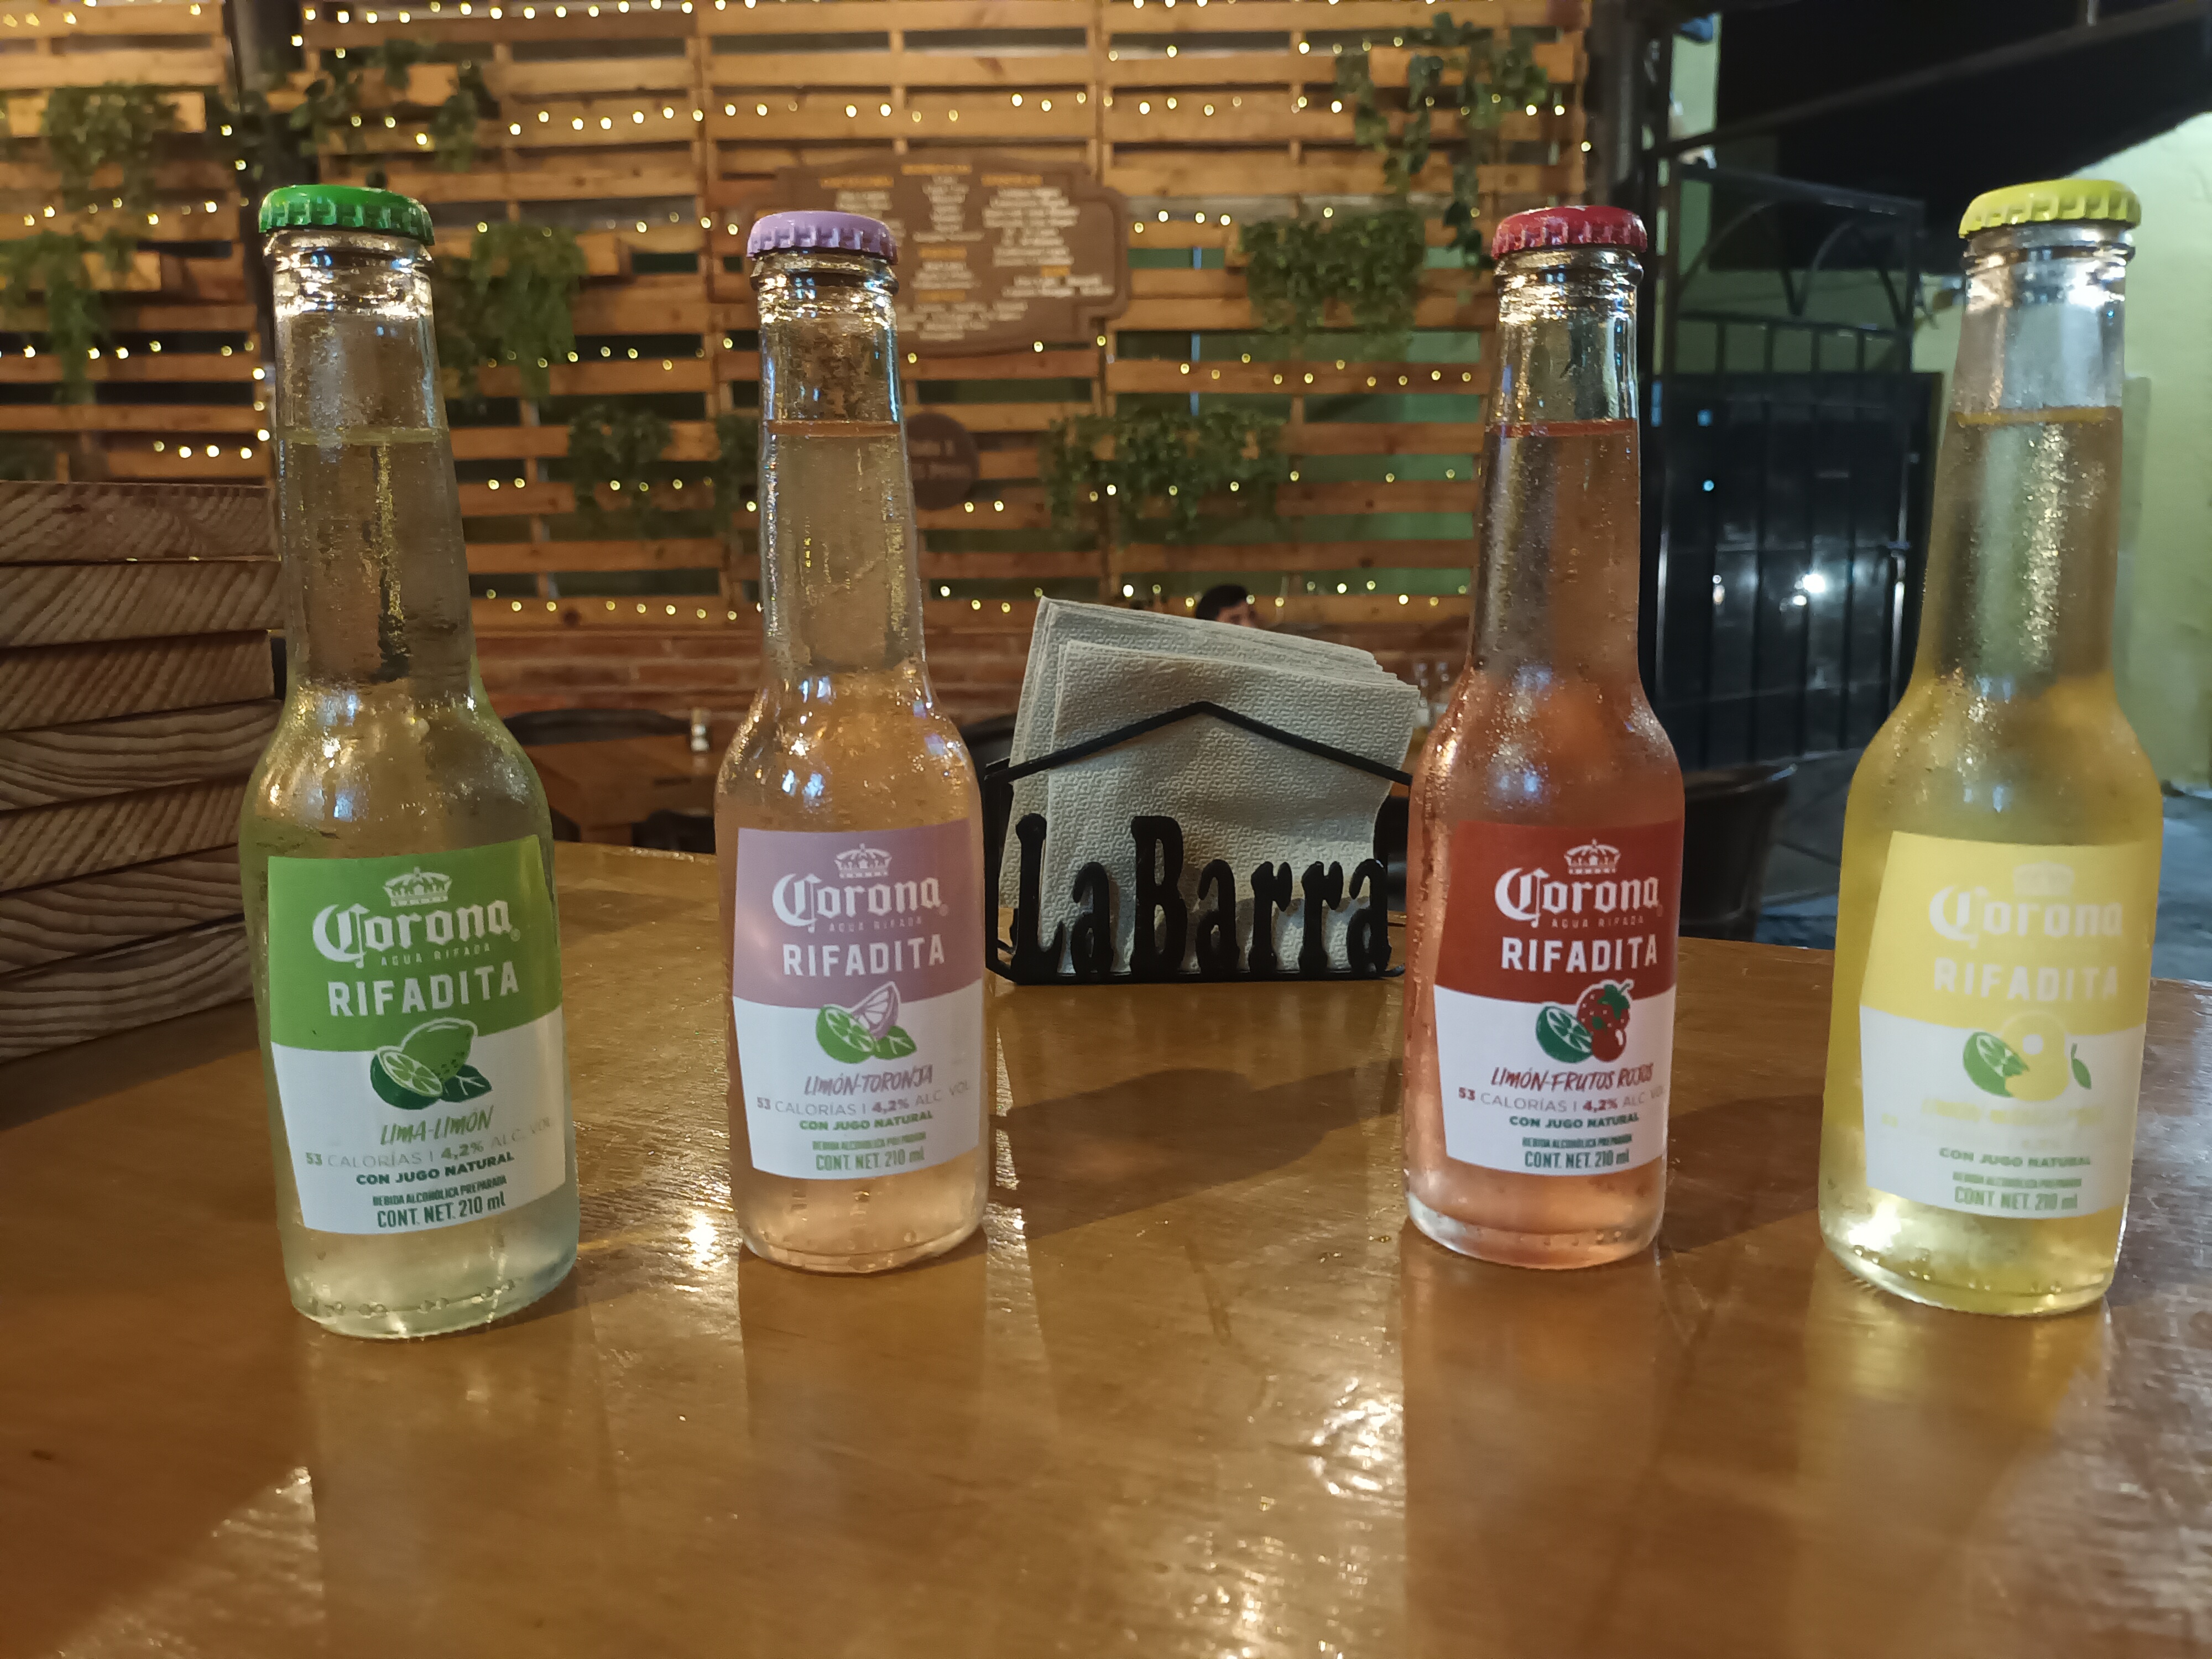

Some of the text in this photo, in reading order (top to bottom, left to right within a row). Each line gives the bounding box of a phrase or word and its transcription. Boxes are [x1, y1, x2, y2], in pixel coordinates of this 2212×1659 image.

[772, 873, 941, 933] Corona
[1010, 813, 1391, 978] La Barra
[1495, 868, 1659, 928] Corona
[312, 900, 512, 968] Corona
[1929, 885, 2122, 949] Corona
[782, 933, 945, 977] RIFADITA
[1501, 933, 1657, 973] RIFADITA
[327, 960, 519, 1016] RIFADITA
[1934, 957, 2118, 1001] RIFADITA
[757, 1097, 771, 1110] 53
[775, 1100, 856, 1116] CALORÍAS
[1458, 1087, 1475, 1100] 53
[1480, 1092, 1566, 1112] CALORÍAS
[800, 1110, 933, 1130] CON JUGO NATURAL
[1509, 1112, 1639, 1129] CON JUGO NATURAL
[306, 1152, 322, 1166] 53
[328, 1151, 422, 1168] CALORÍAS
[441, 1142, 484, 1160] 4,2%
[356, 1151, 515, 1185] CON JUGO NATURAL
[884, 1148, 905, 1166] 210
[1939, 1147, 1974, 1161] CON
[458, 1196, 484, 1218] 210
[487, 1191, 507, 1211] ml
